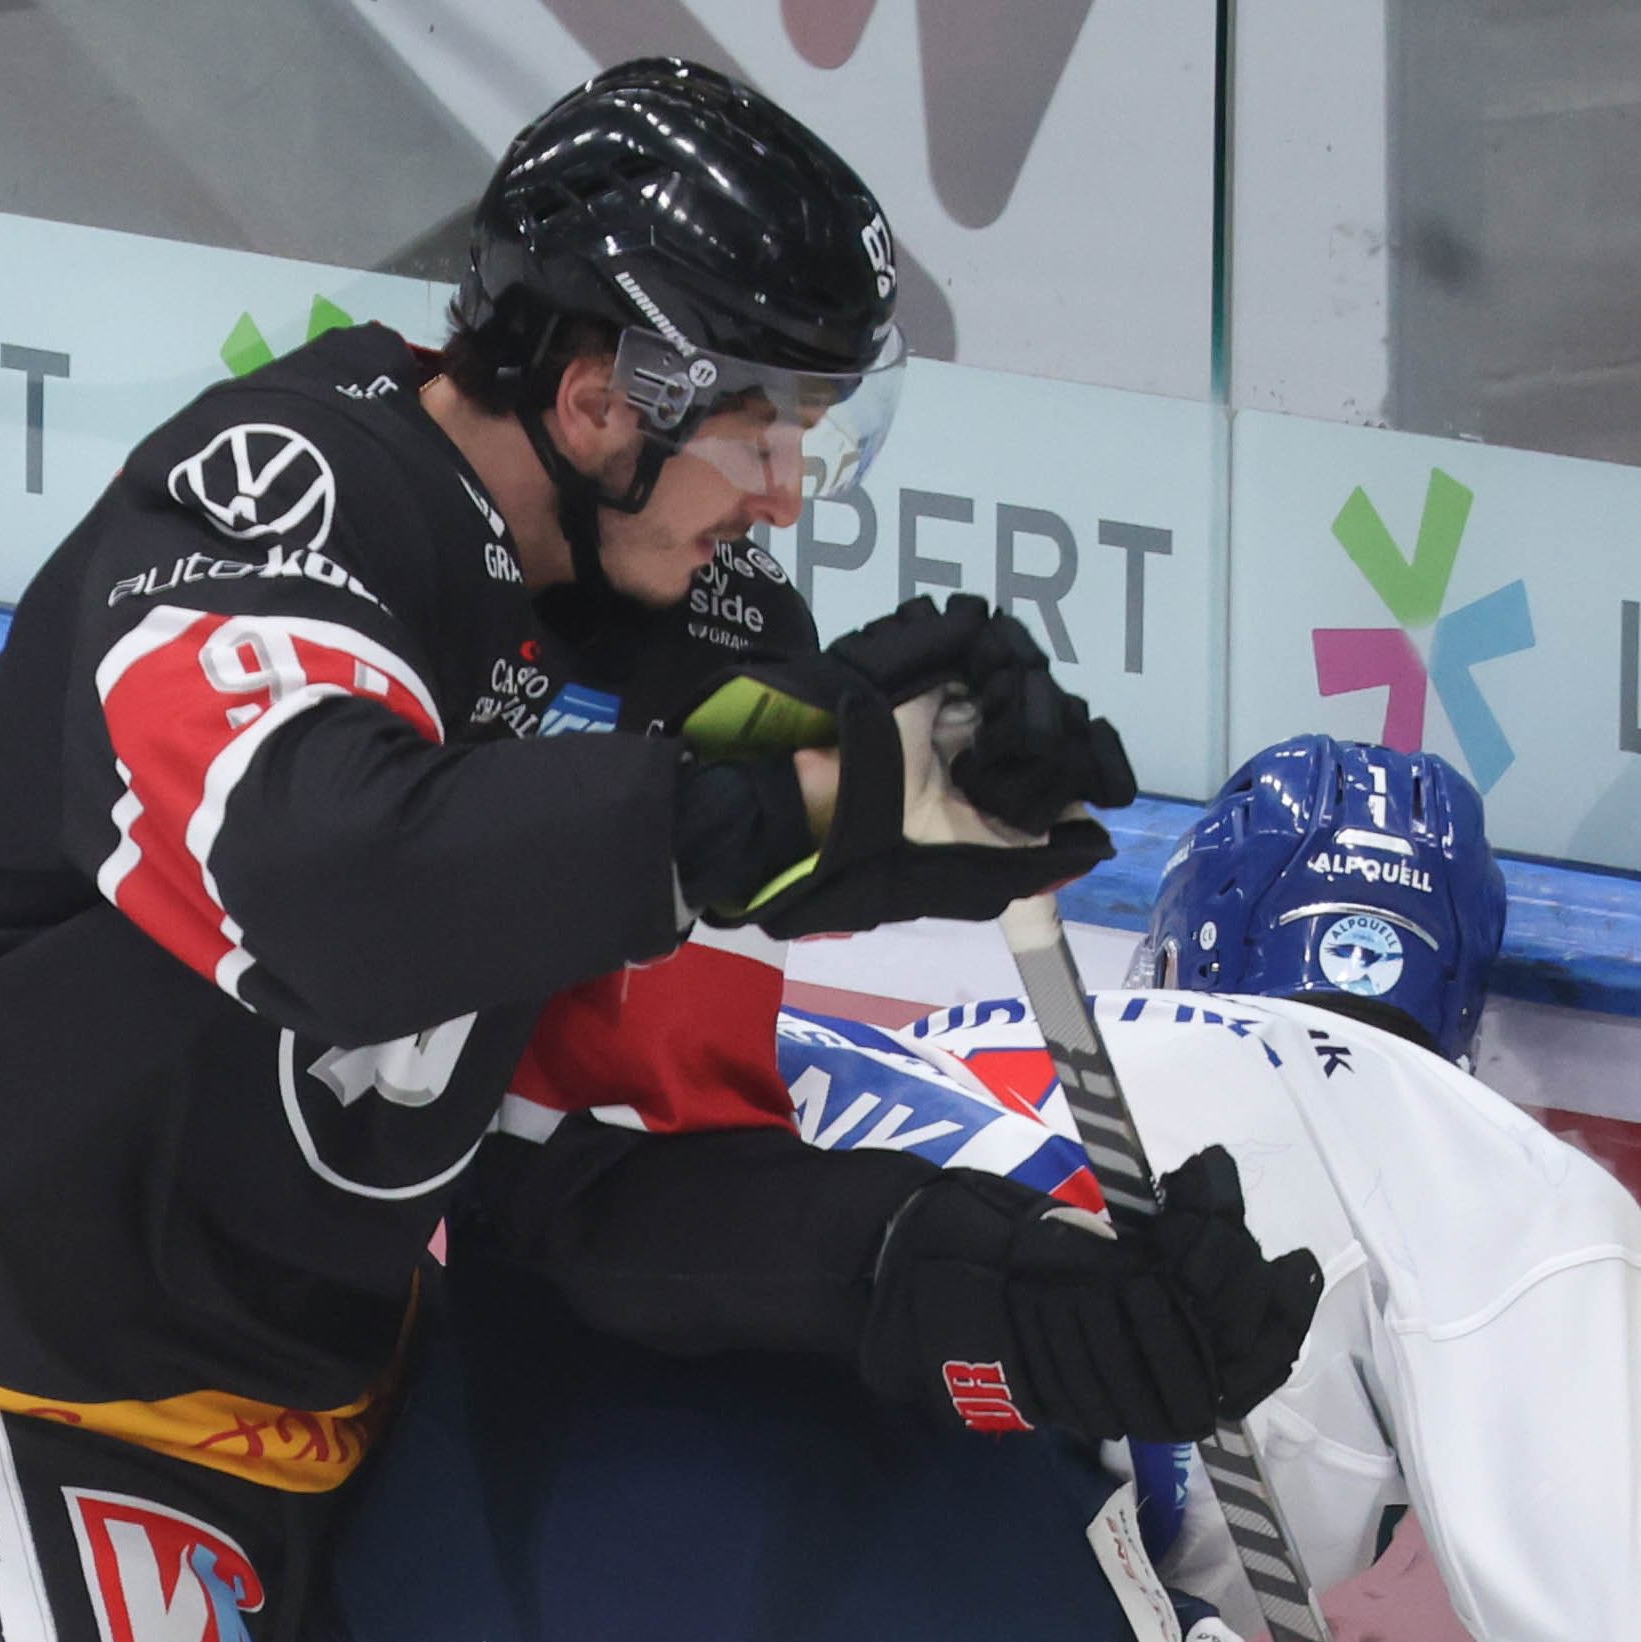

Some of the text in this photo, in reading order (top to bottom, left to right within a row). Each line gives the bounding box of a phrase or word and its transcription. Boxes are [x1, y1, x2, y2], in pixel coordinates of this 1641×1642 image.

[689, 588, 764, 633] side
[1314, 852, 1434, 893] ALPQUELL
[1330, 916, 1399, 949] ALPQUELL
